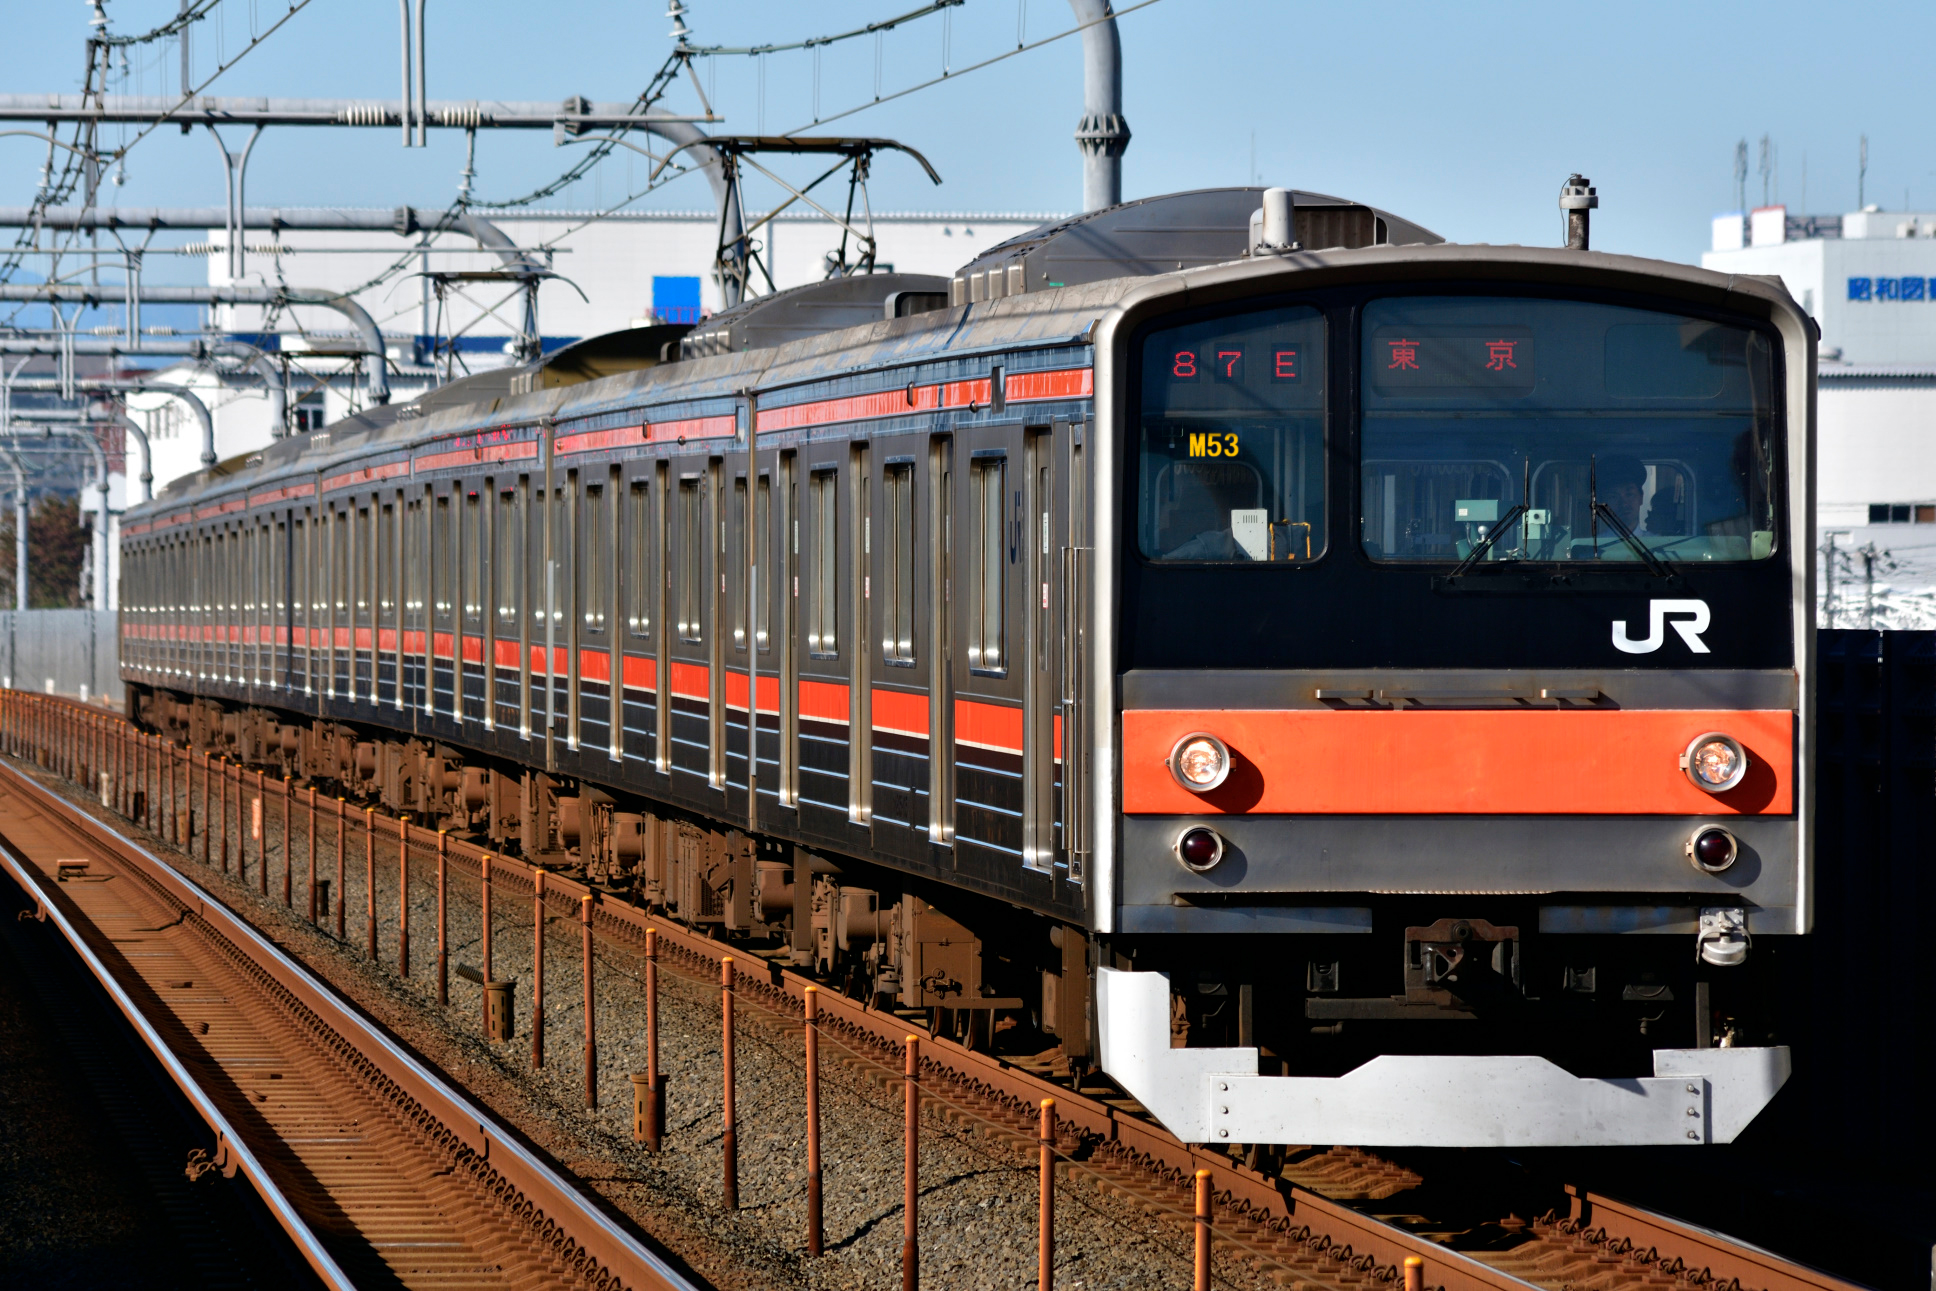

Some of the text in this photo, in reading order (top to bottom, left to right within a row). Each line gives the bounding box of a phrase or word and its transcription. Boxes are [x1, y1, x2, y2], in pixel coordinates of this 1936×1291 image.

[1847, 276, 1936, 302] 昭和図
[1387, 338, 1518, 371] 東京
[1189, 432, 1239, 457] M53
[1611, 599, 1711, 654] JR
